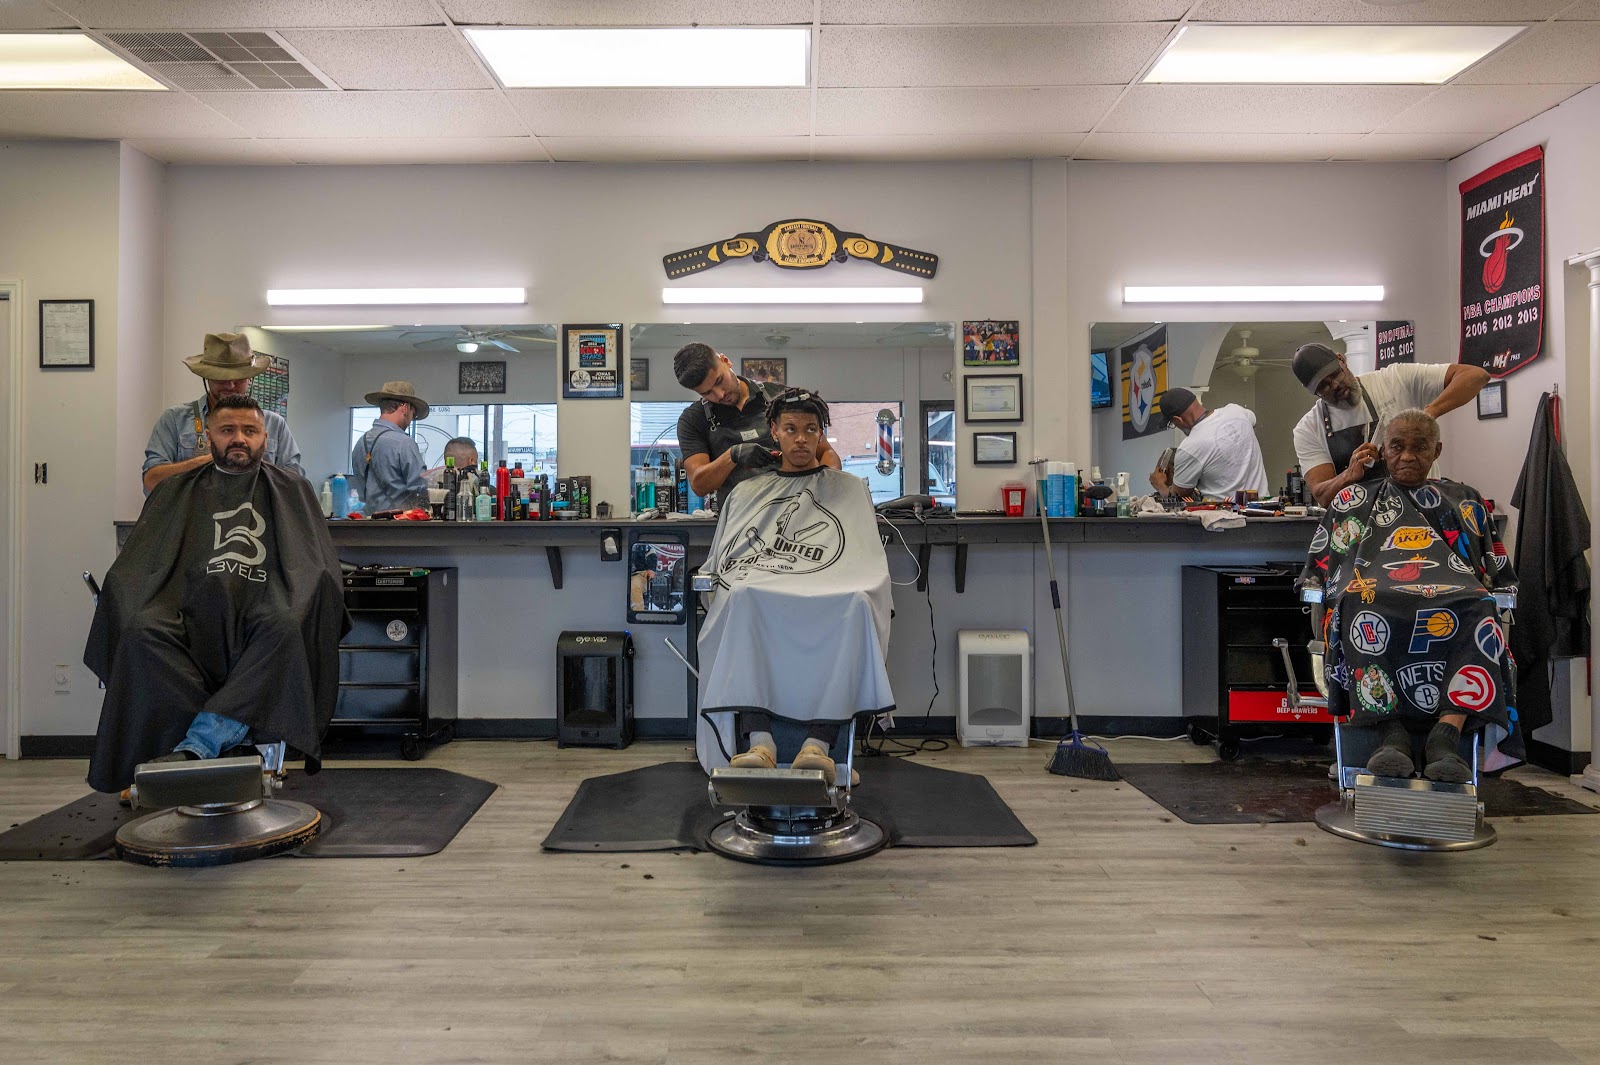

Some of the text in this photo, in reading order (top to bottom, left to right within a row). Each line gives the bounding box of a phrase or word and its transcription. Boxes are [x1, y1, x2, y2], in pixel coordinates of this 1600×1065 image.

[1467, 173, 1539, 220] MIAMI HEAT
[1463, 285, 1541, 320] NBA CHAMPIONS
[1465, 307, 1538, 338] 2006 2012 2013
[774, 537, 824, 561] UNITED
[1400, 663, 1444, 689] NETS
[1281, 698, 1287, 708] 6
[1422, 688, 1434, 706] B
